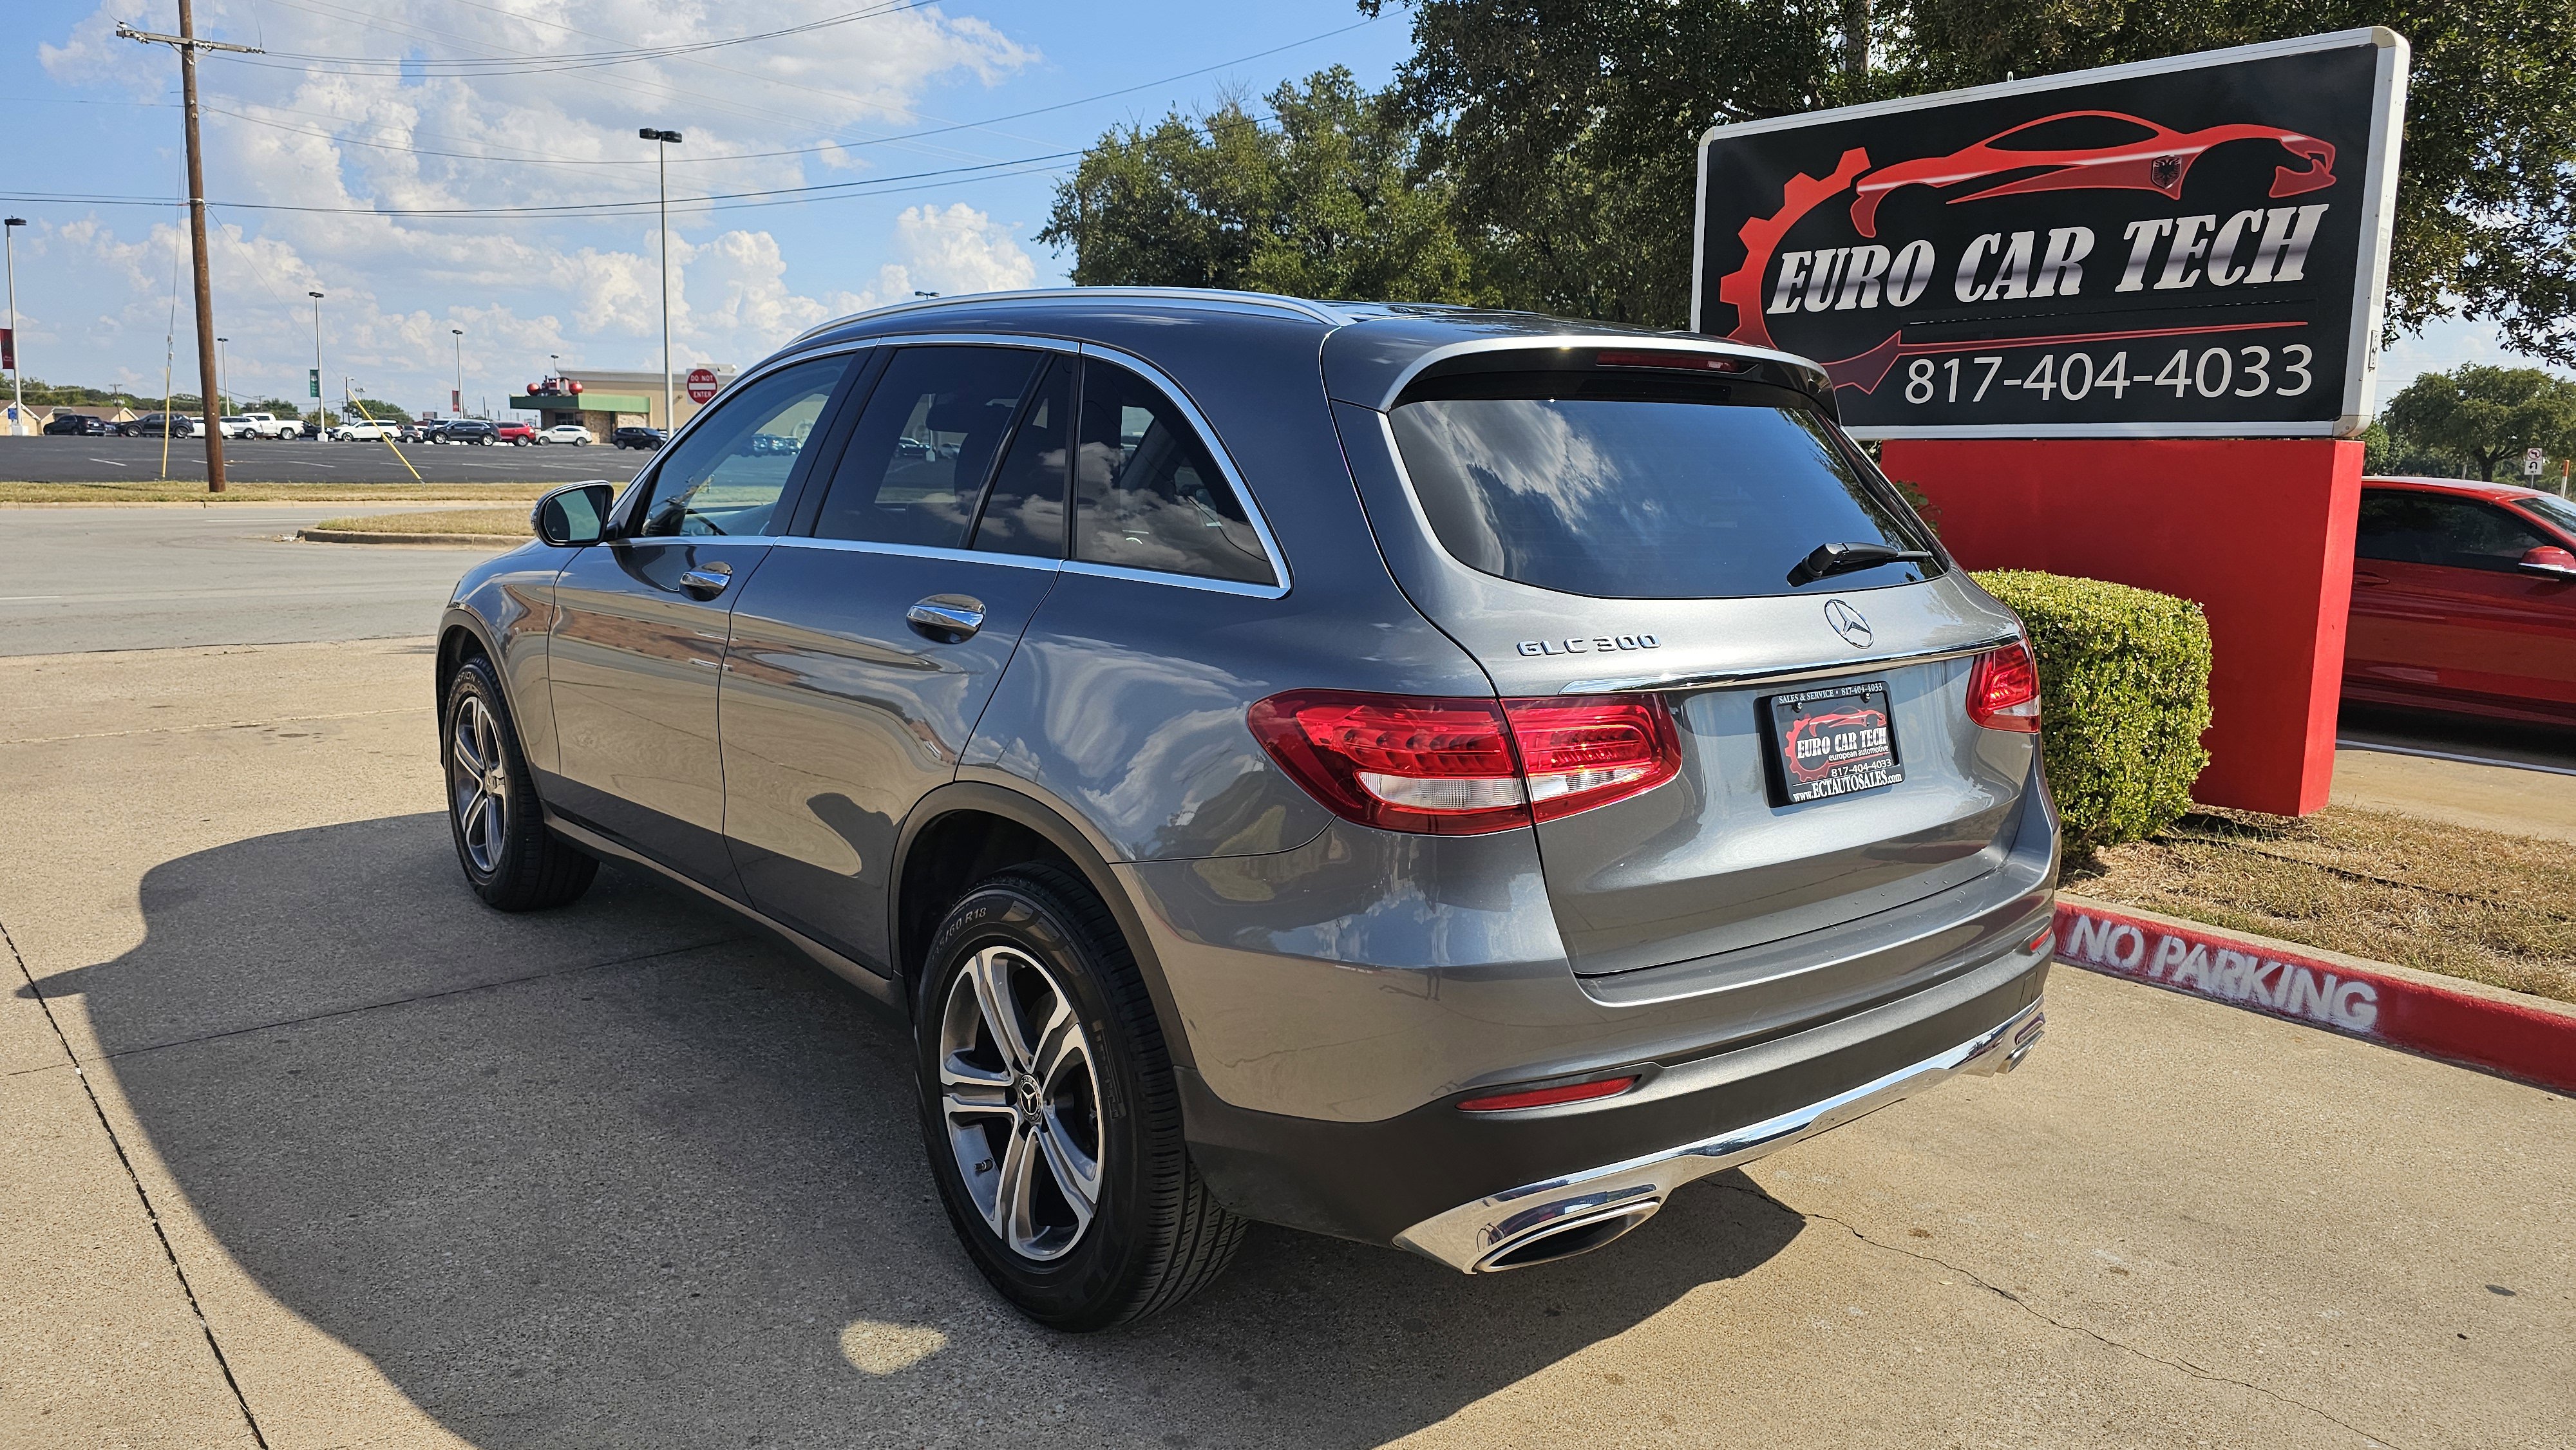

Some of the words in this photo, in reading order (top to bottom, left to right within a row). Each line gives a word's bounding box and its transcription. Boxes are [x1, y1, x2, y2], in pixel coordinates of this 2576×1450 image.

[1766, 240, 1935, 314] EURO
[1954, 226, 2096, 303] CAR
[2115, 203, 2329, 292] TECH
[1904, 344, 2313, 404] 817-404-4033
[1517, 637, 1588, 656] GLC
[1593, 633, 1661, 652] 300
[1779, 694, 1799, 704] SALES
[1806, 690, 1834, 699] SERVICE
[1841, 683, 1882, 695] 817-404-4033
[1797, 736, 1831, 758] EURO
[1834, 732, 1858, 752] CAR
[1860, 727, 1887, 748] TECH
[1828, 751, 1858, 761] european
[1858, 745, 1889, 757] automotive
[1831, 758, 1892, 777] 817-404-4033
[1793, 769, 1902, 802] www.ECTAUTOSALES.com
[965, 907, 987, 923] R18
[2067, 914, 2144, 968] NO
[2152, 935, 2379, 1031] PARKING
